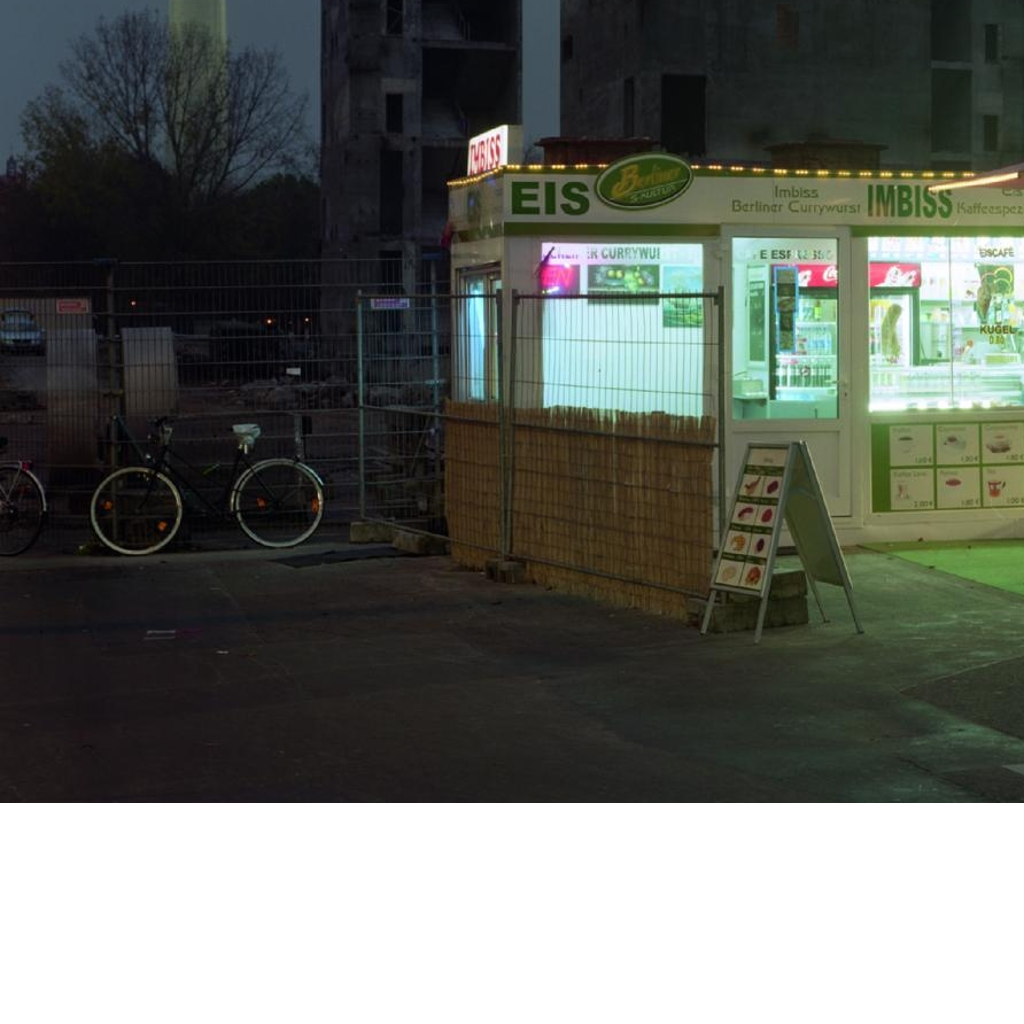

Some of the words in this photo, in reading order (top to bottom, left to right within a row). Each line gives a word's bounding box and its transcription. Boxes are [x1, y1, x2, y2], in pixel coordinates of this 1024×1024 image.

[512, 181, 590, 215] EIS
[774, 185, 819, 198] Imbiss
[867, 183, 954, 219] IMBISS
[731, 199, 783, 213] Berliner
[788, 199, 862, 216] Currywurst
